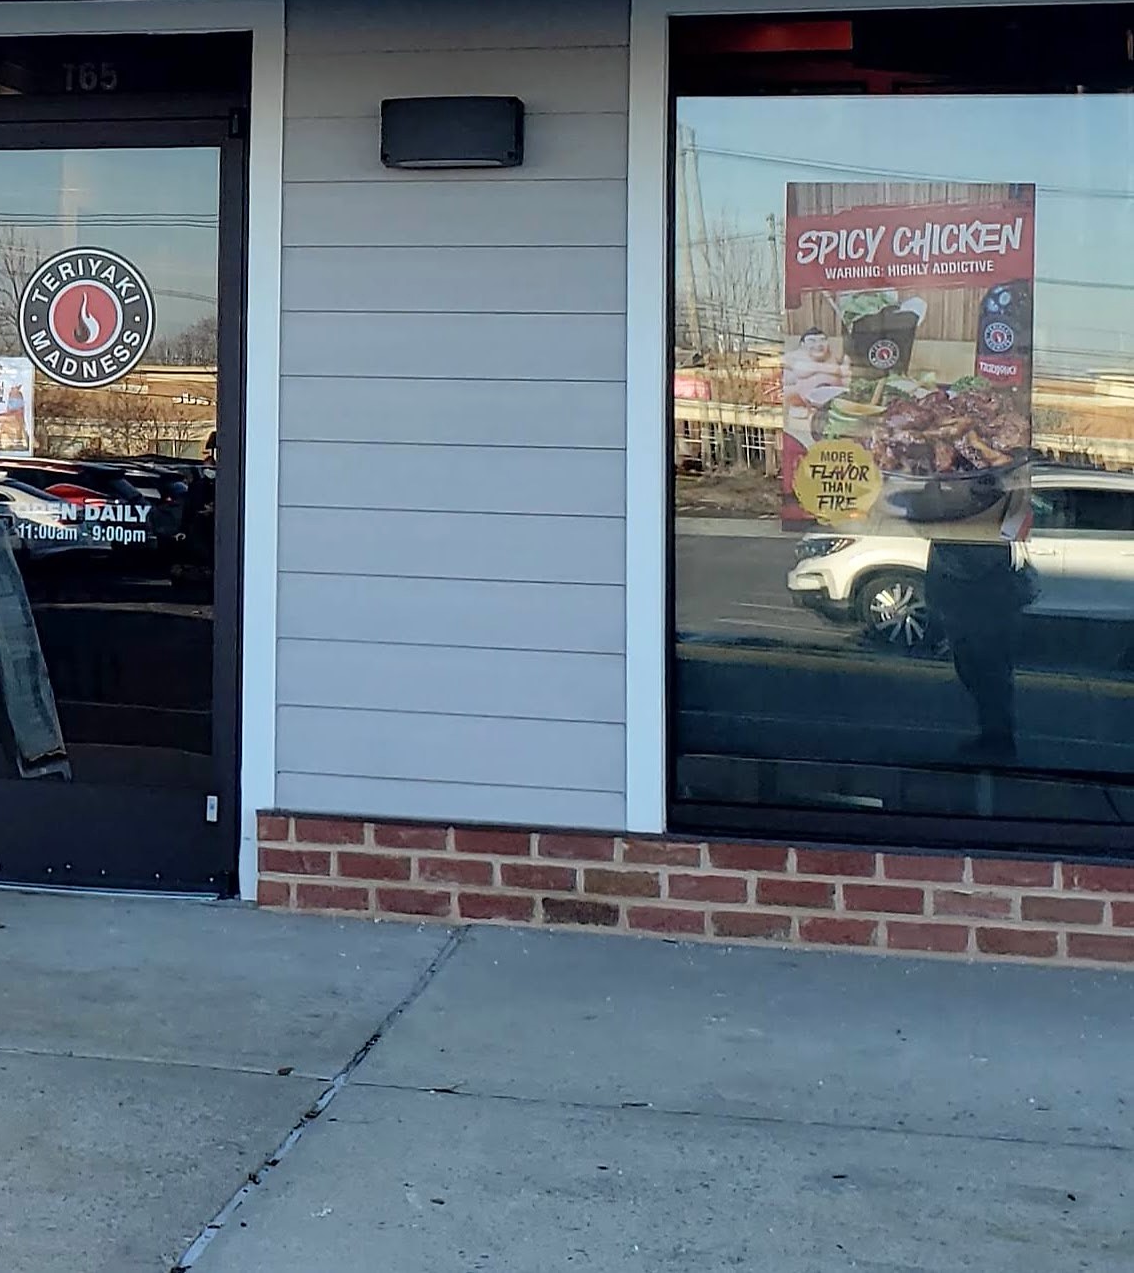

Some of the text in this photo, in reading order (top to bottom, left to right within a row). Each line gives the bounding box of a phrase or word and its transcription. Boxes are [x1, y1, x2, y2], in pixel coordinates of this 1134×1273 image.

[796, 217, 1023, 265] SPICY CHICKEN
[825, 260, 995, 279] WARNING: HIGHLY ADDICTIVE
[31, 258, 141, 304] TERIYAKI
[30, 329, 141, 379] MADNESS
[820, 451, 854, 463] MORE
[809, 463, 870, 482] FLAVOR
[822, 481, 853, 493] THAN
[816, 494, 858, 512] FIRE
[84, 504, 152, 523] DAILY
[18, 523, 78, 541] 11:00am
[91, 525, 147, 545] 9:00pm
